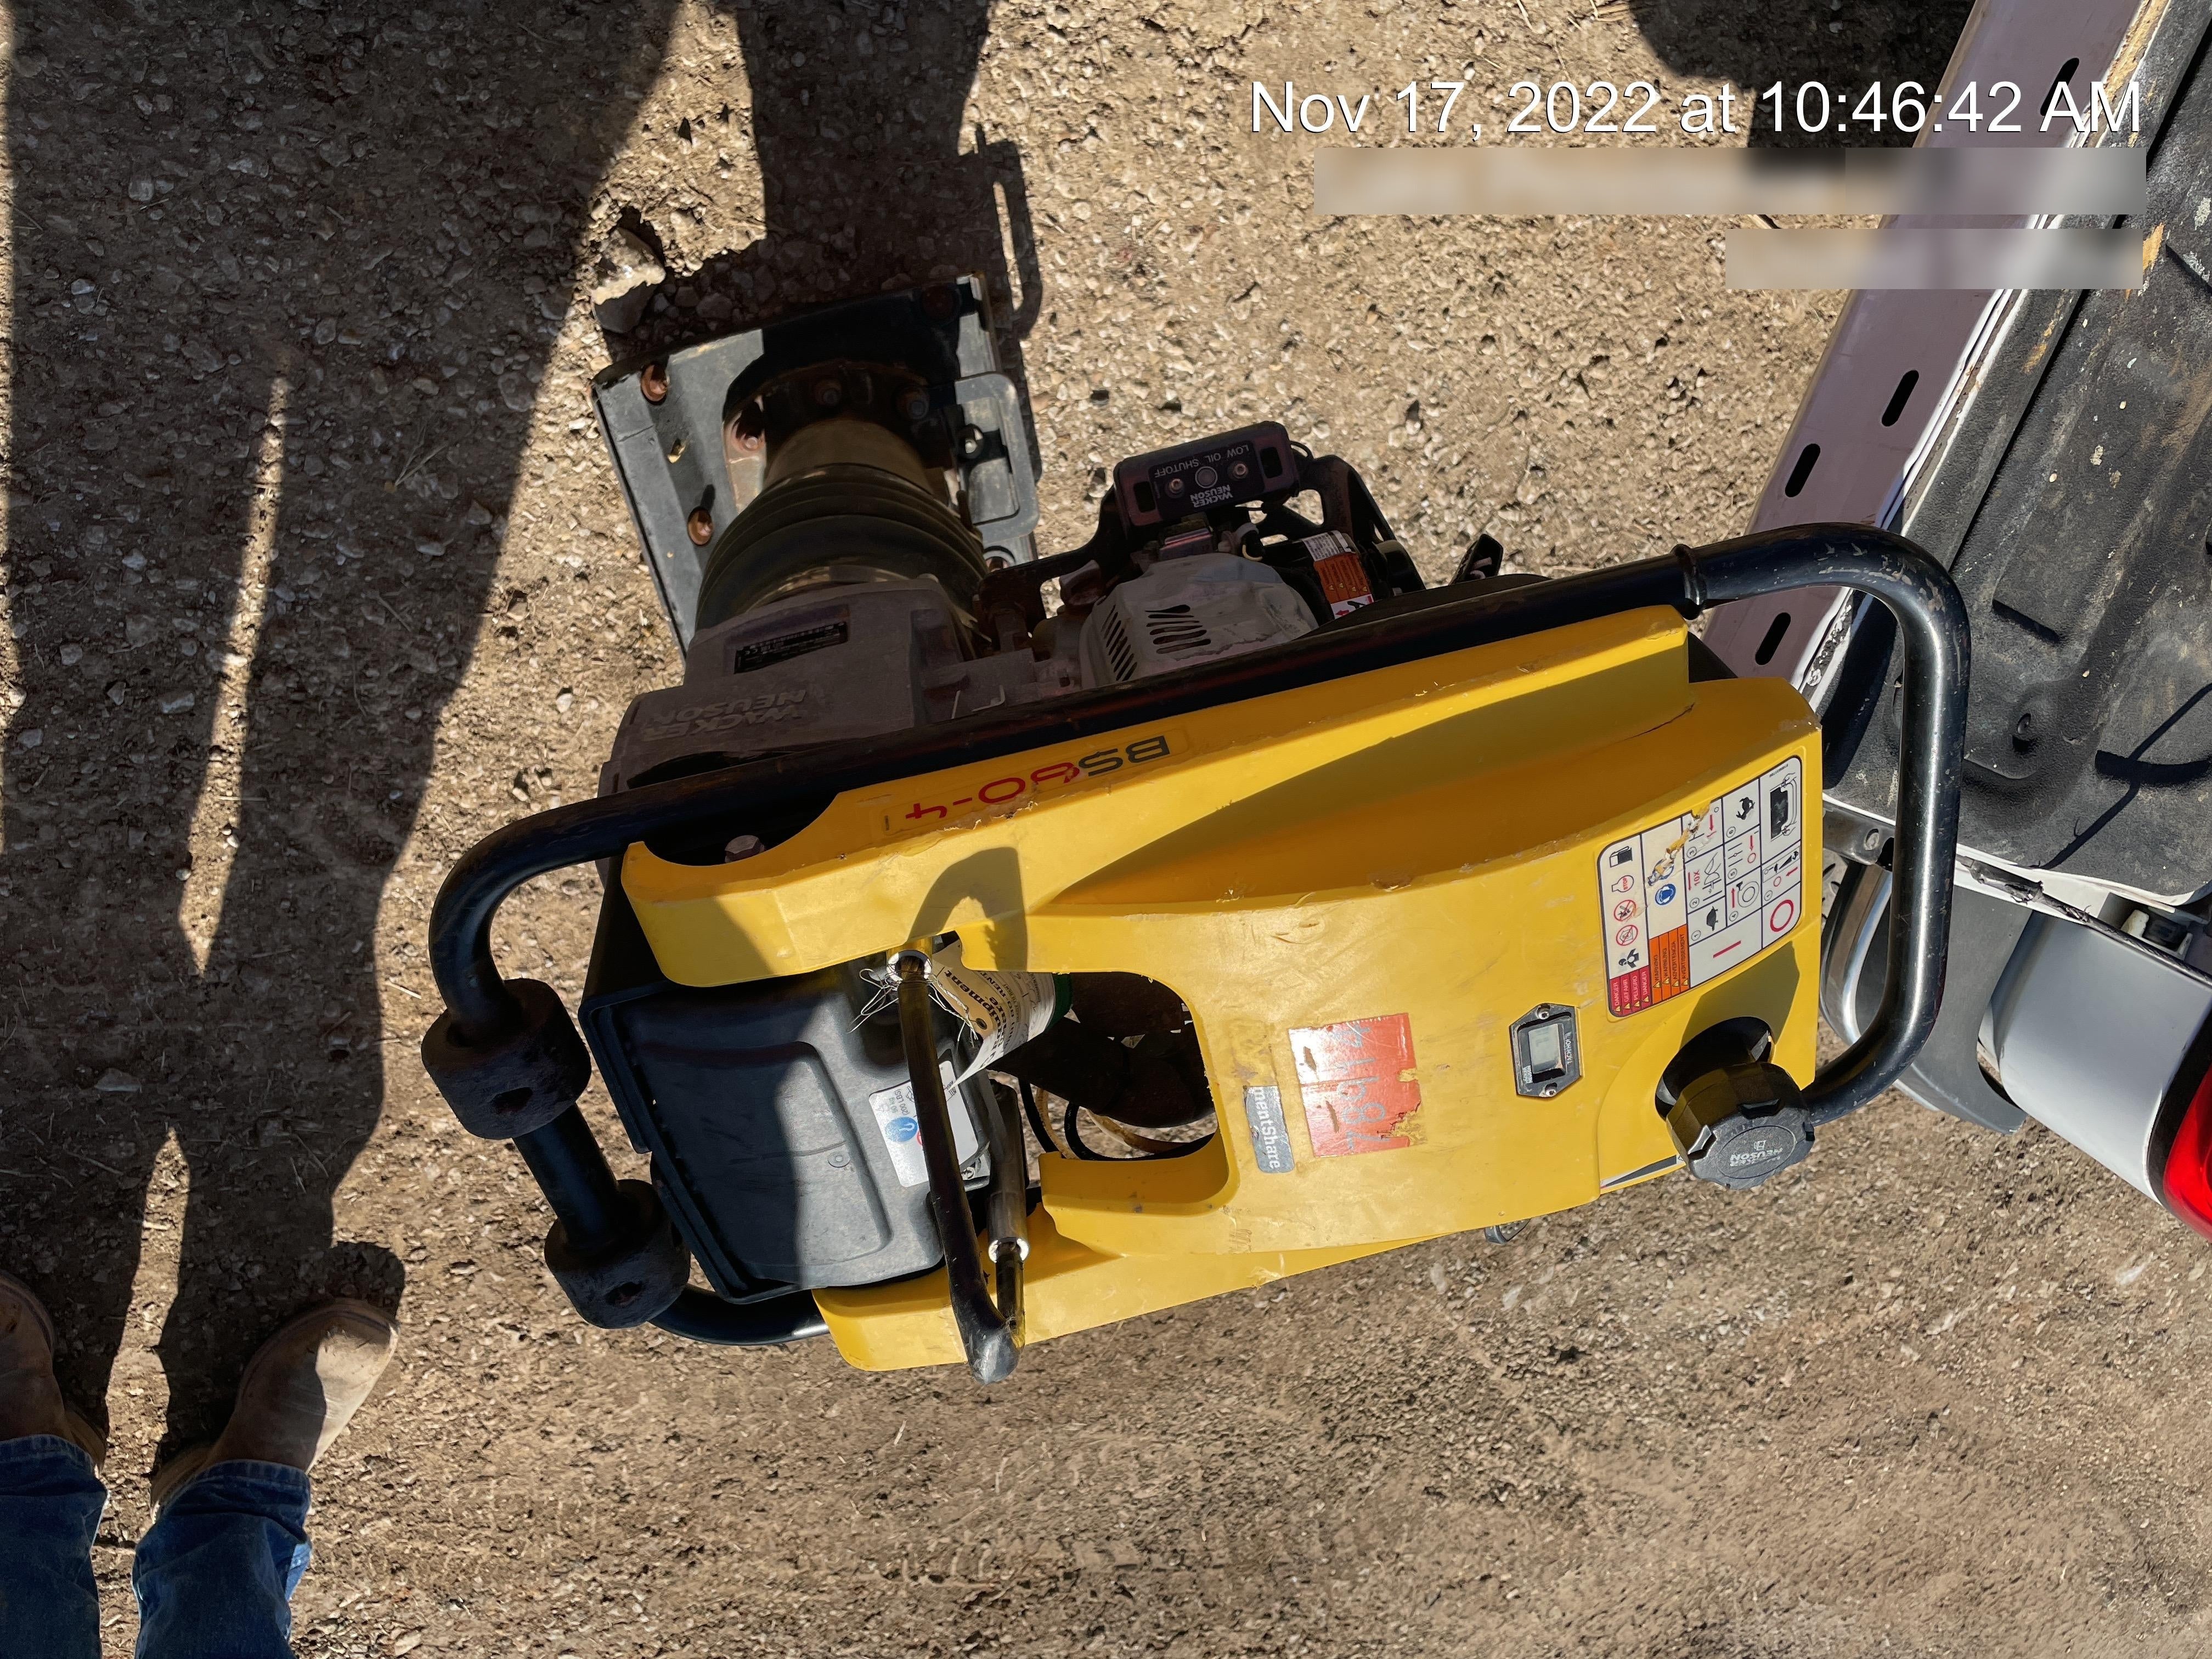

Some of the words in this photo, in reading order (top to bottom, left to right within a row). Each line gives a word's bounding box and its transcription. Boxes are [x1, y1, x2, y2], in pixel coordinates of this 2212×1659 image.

[1204, 453, 1221, 463] OIL
[1226, 444, 1249, 458] LOW
[1154, 459, 1200, 478] SHUTOFF
[1189, 484, 1231, 501] NEUSON
[1192, 492, 1234, 508] WACKER
[653, 689, 806, 725] NEUSON
[643, 704, 803, 741] WACKER
[905, 735, 1171, 820] BS60-4
[1330, 1023, 1392, 1150] 78914
[894, 1089, 904, 1103] LBS)
[899, 1103, 910, 1116] (200
[1254, 1088, 1281, 1170] mentShare
